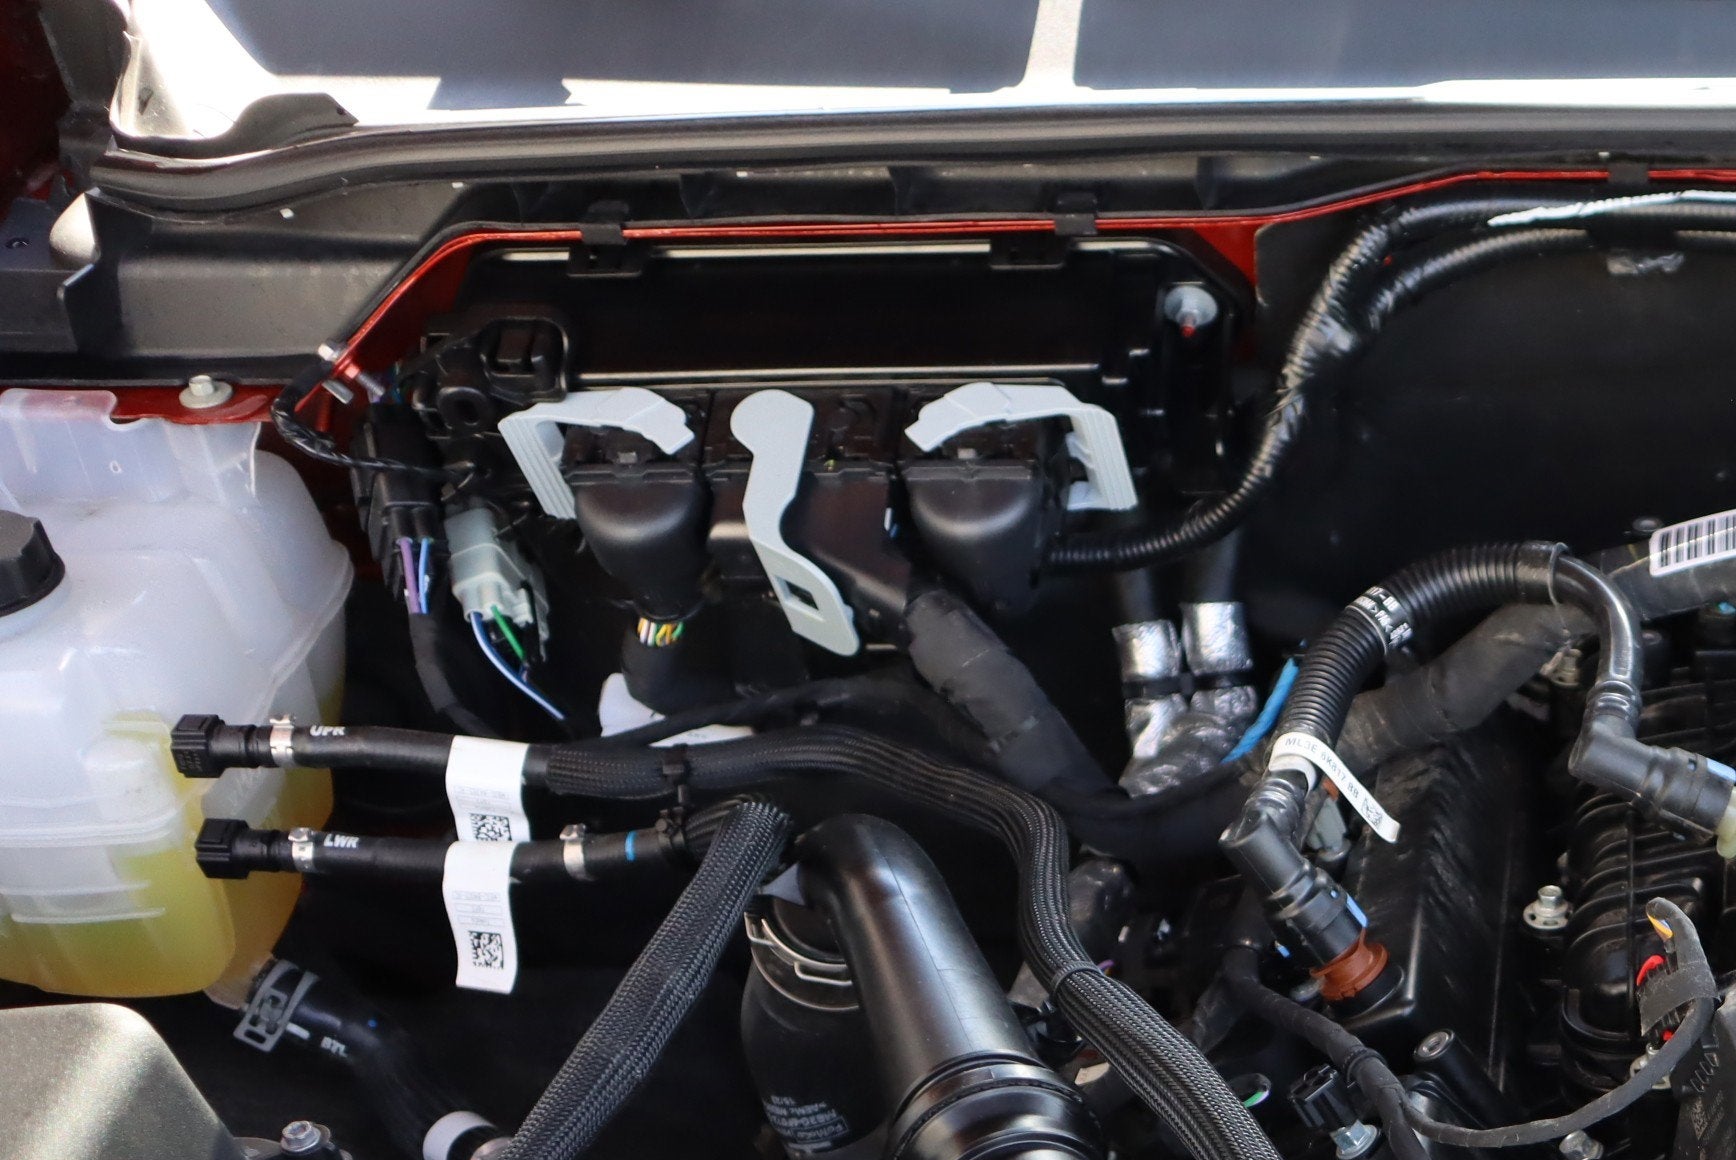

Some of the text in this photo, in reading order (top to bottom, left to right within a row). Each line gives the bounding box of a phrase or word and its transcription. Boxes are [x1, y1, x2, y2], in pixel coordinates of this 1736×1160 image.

[309, 724, 346, 737] UPR
[1284, 737, 1319, 754] ML3E
[323, 833, 360, 849] LWR
